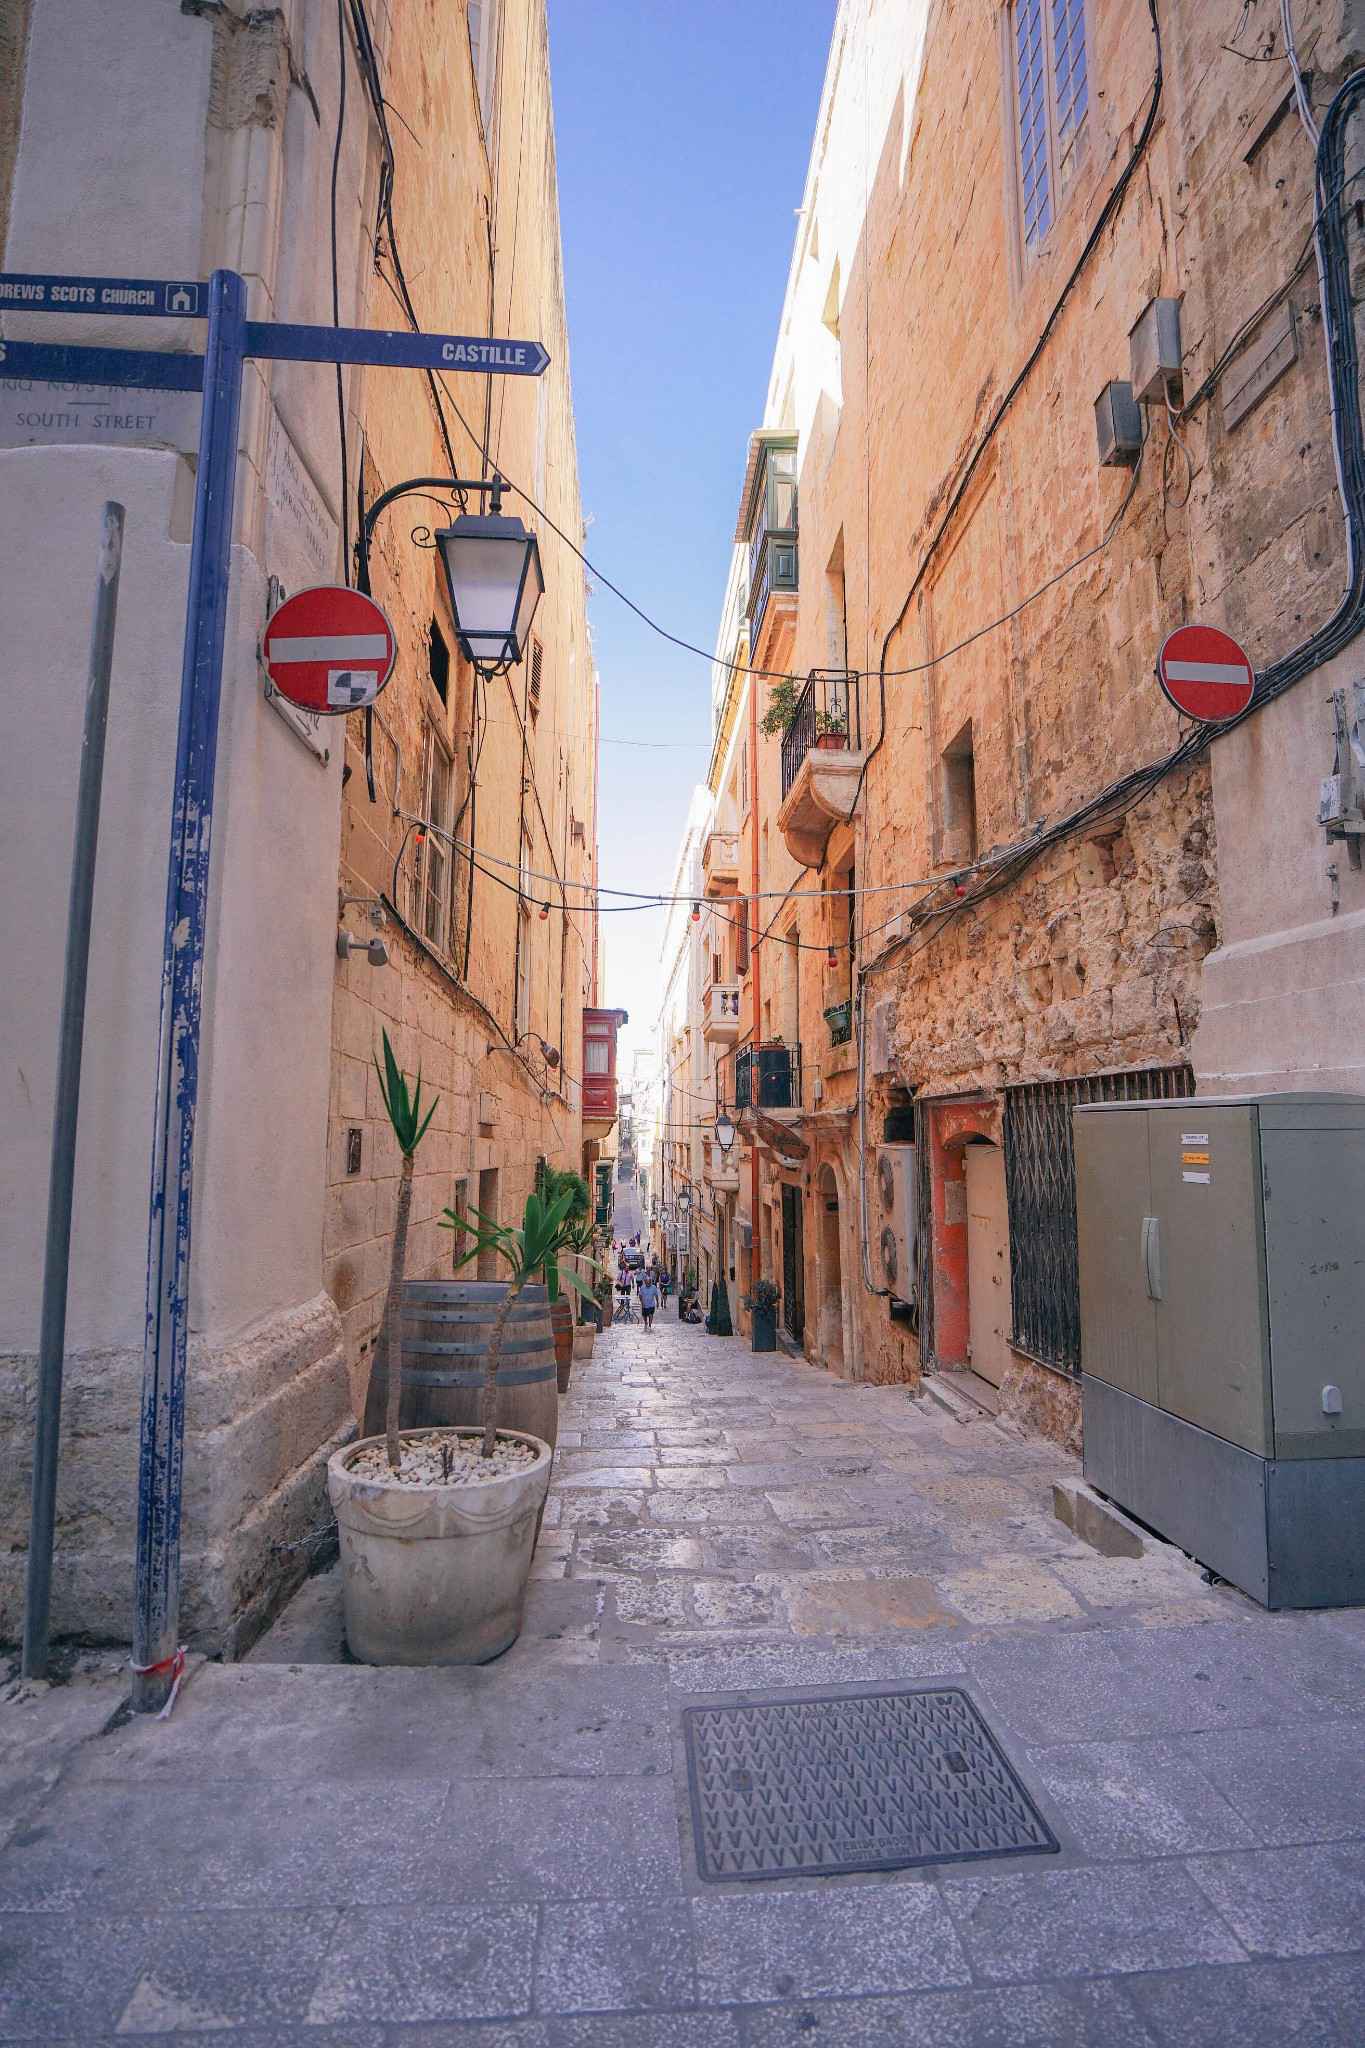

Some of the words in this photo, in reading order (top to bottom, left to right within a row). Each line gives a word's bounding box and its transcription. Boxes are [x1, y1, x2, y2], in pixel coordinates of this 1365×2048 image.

[50, 286, 96, 303] SCOTS
[102, 288, 156, 305] CHURCH
[442, 343, 526, 366] CASTILLE
[16, 412, 80, 427] SOUTH
[92, 414, 157, 430] STREET
